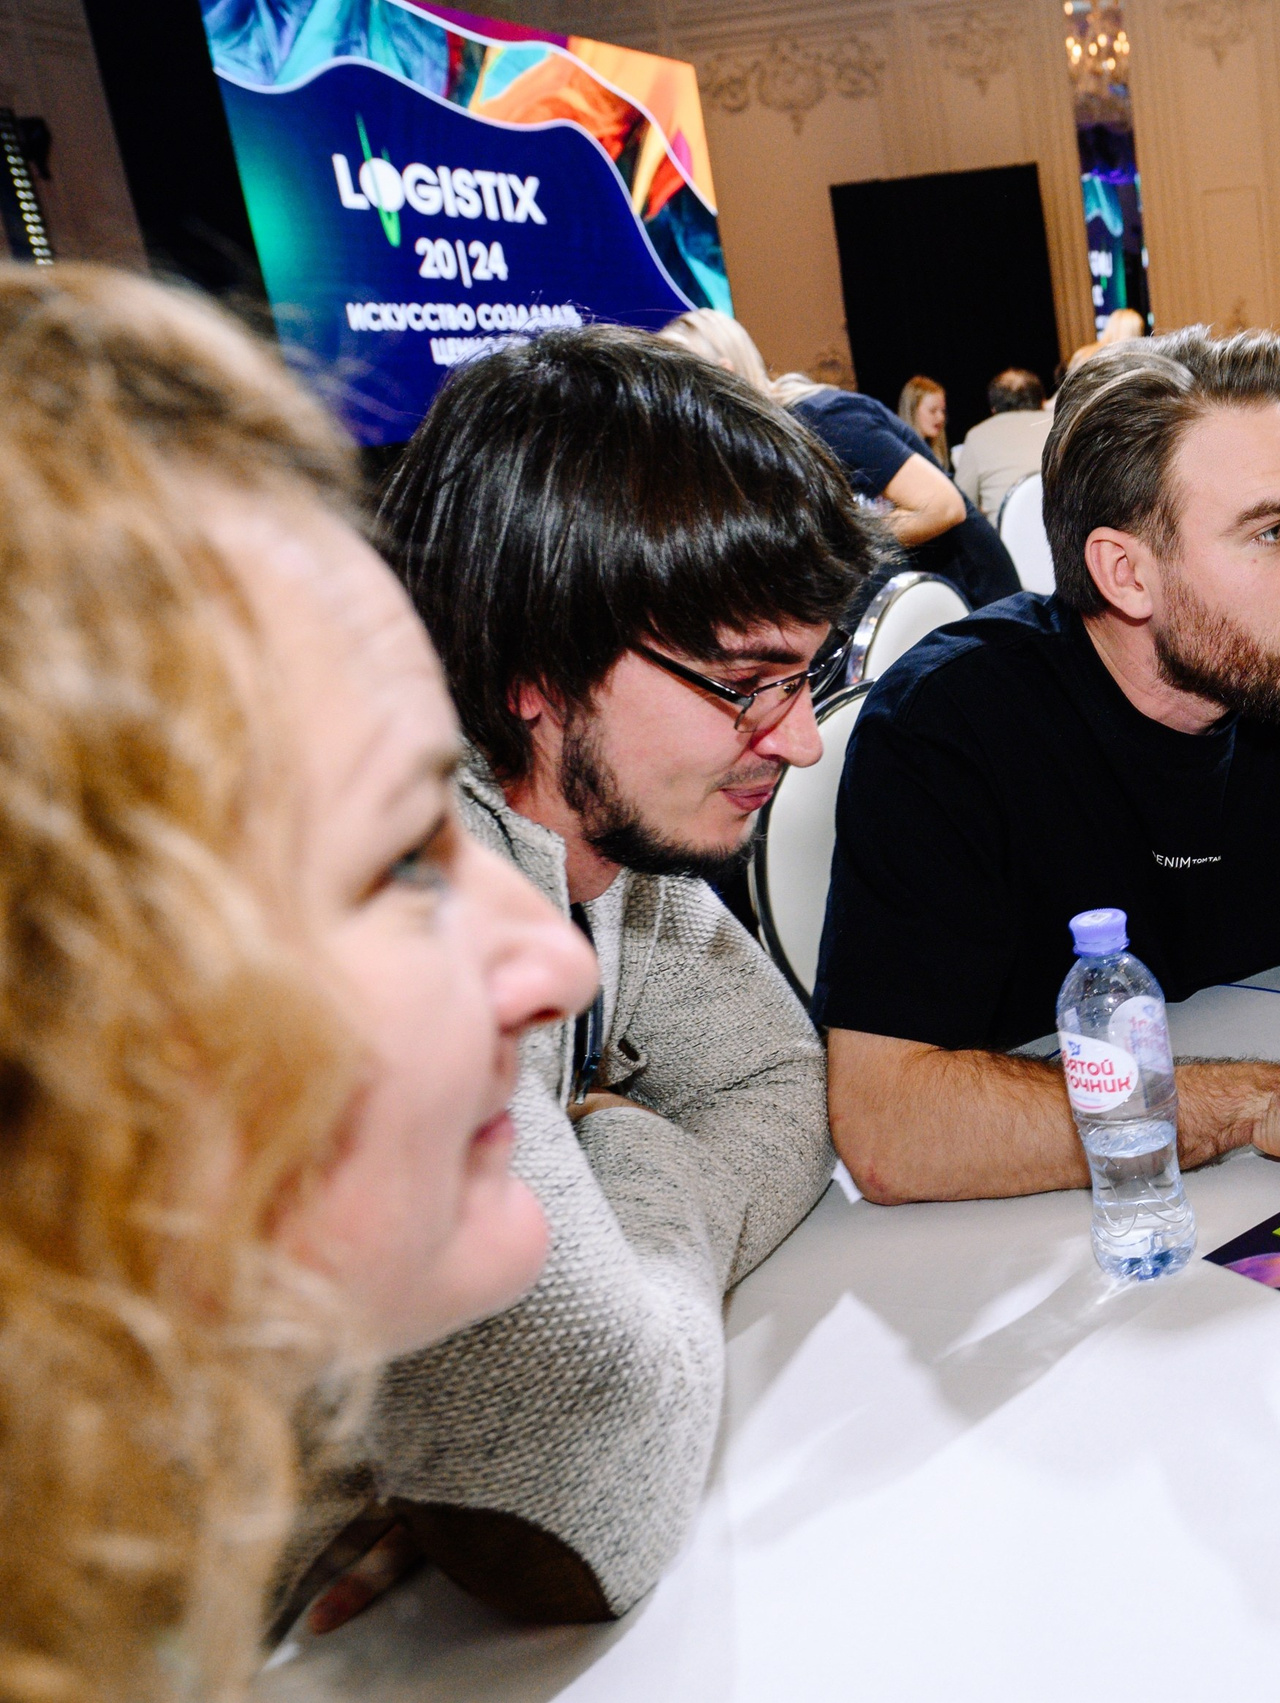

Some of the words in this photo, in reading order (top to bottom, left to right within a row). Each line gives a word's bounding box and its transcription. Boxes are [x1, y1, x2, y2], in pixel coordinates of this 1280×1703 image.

[331, 153, 547, 225] LOGISTIX
[415, 237, 508, 288] 20|24
[346, 302, 476, 331] ИСКУССТВО
